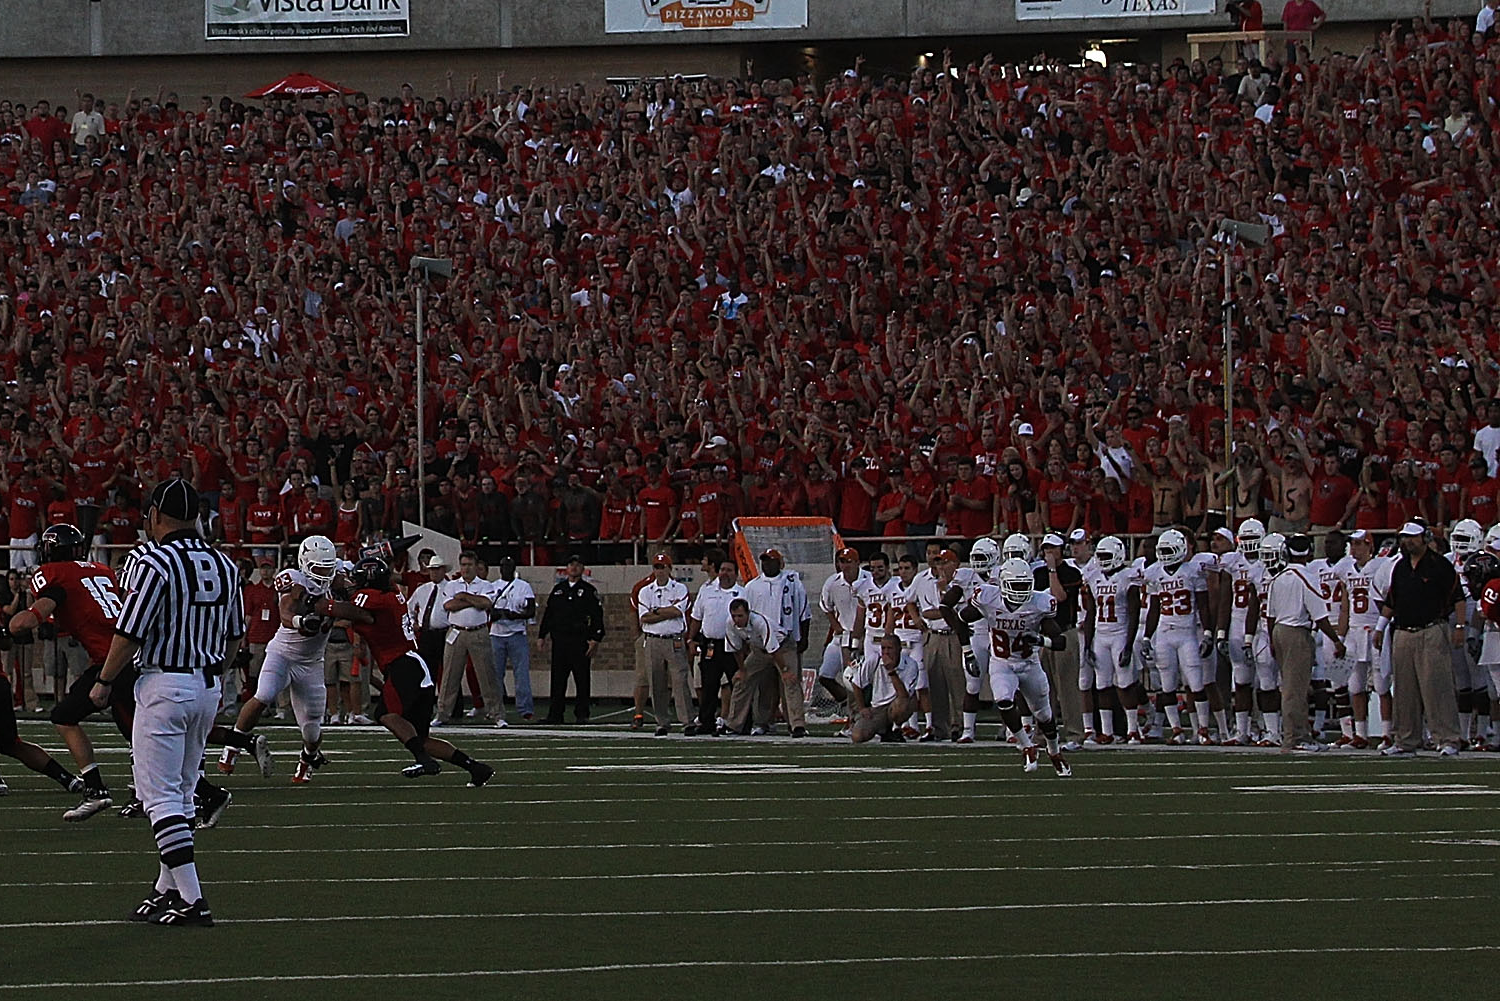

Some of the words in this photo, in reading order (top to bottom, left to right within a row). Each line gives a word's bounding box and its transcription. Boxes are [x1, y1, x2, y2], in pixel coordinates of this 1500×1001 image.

[665, 9, 749, 20] PIZZAWORKS
[30, 571, 48, 593] 16
[187, 551, 222, 603] B
[1161, 579, 1184, 591] TEXAS
[353, 592, 369, 607] 41
[1097, 585, 1117, 594] TEXAS
[1352, 587, 1369, 614] 6
[1098, 595, 1118, 622] 11
[1159, 589, 1192, 616] 23
[996, 618, 1026, 630] TEXAS
[992, 628, 1033, 659] 84
